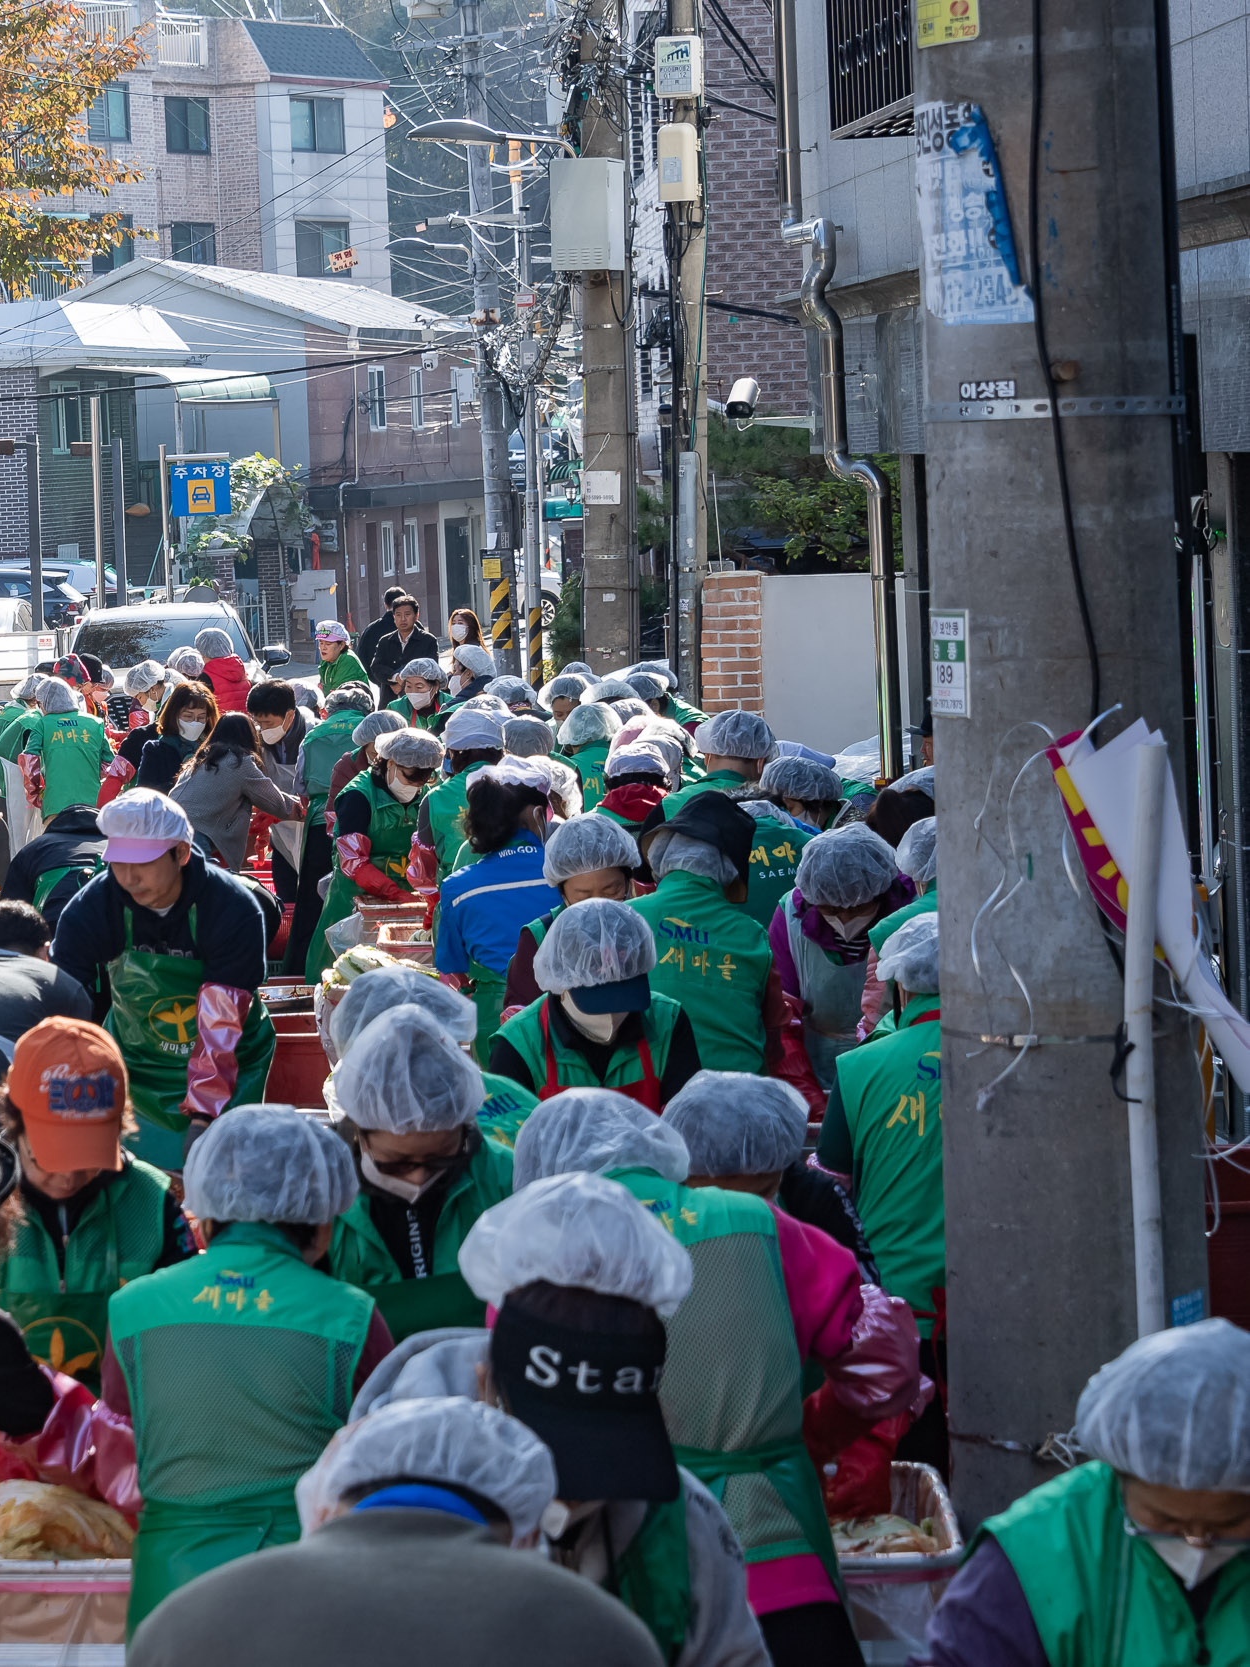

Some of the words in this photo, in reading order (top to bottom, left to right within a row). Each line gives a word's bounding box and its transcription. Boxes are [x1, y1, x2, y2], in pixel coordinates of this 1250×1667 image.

[667, 45, 689, 62] FTTH
[960, 380, 1015, 399] 이삿짐
[174, 465, 226, 479] 주차장
[936, 664, 953, 684] 189
[51, 729, 90, 744] 새마을
[657, 919, 709, 945] SMU
[659, 947, 737, 981] 새마을
[214, 1273, 254, 1289] SMU
[193, 1286, 274, 1312] 새마을
